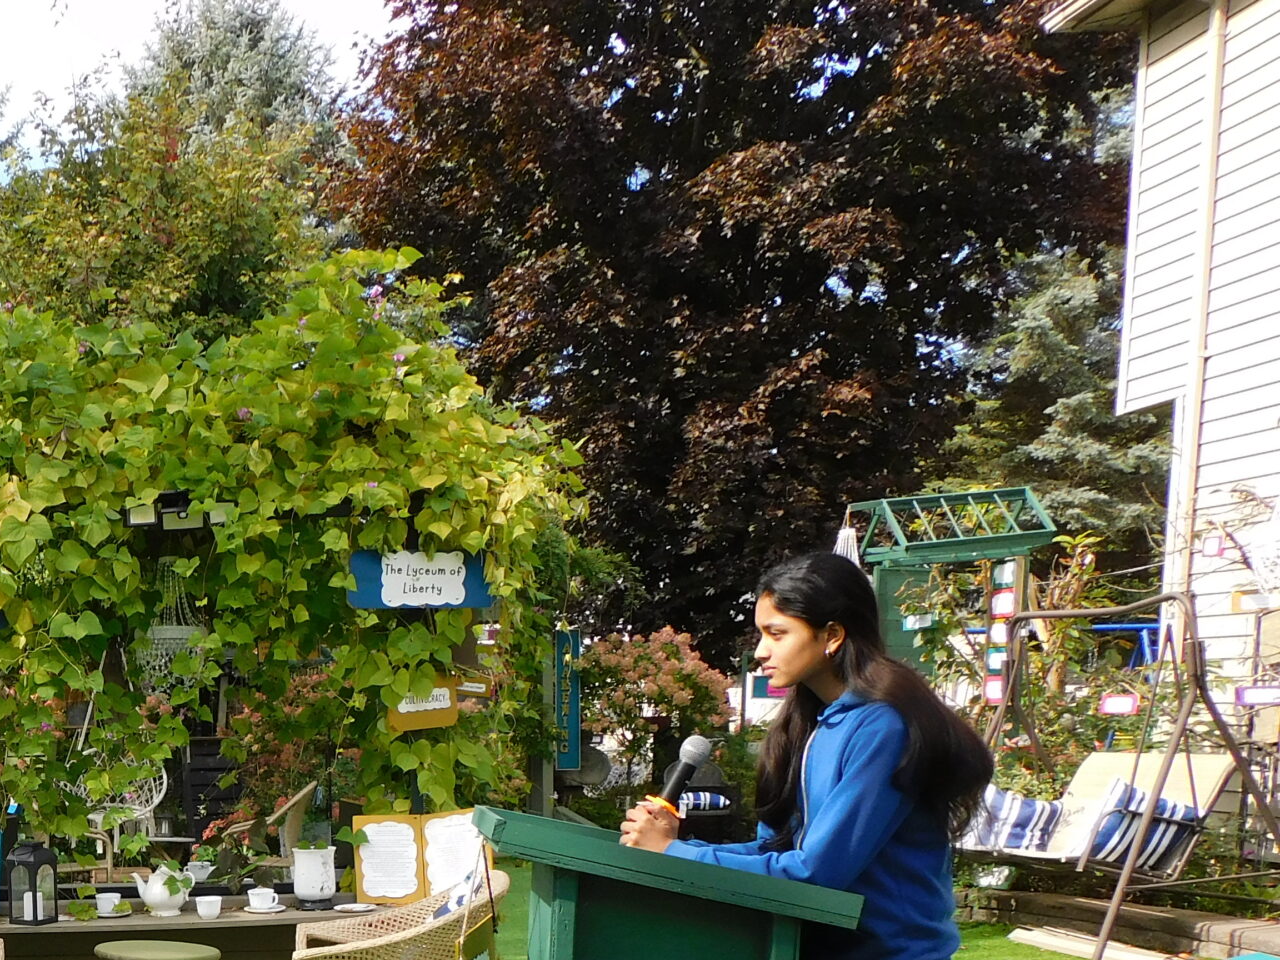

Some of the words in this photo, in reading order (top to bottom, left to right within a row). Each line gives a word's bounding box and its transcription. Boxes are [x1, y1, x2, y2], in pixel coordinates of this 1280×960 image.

[384, 563, 403, 576] The
[406, 564, 446, 577] Lyceum
[449, 566, 463, 576] of
[403, 582, 442, 596] Liberty
